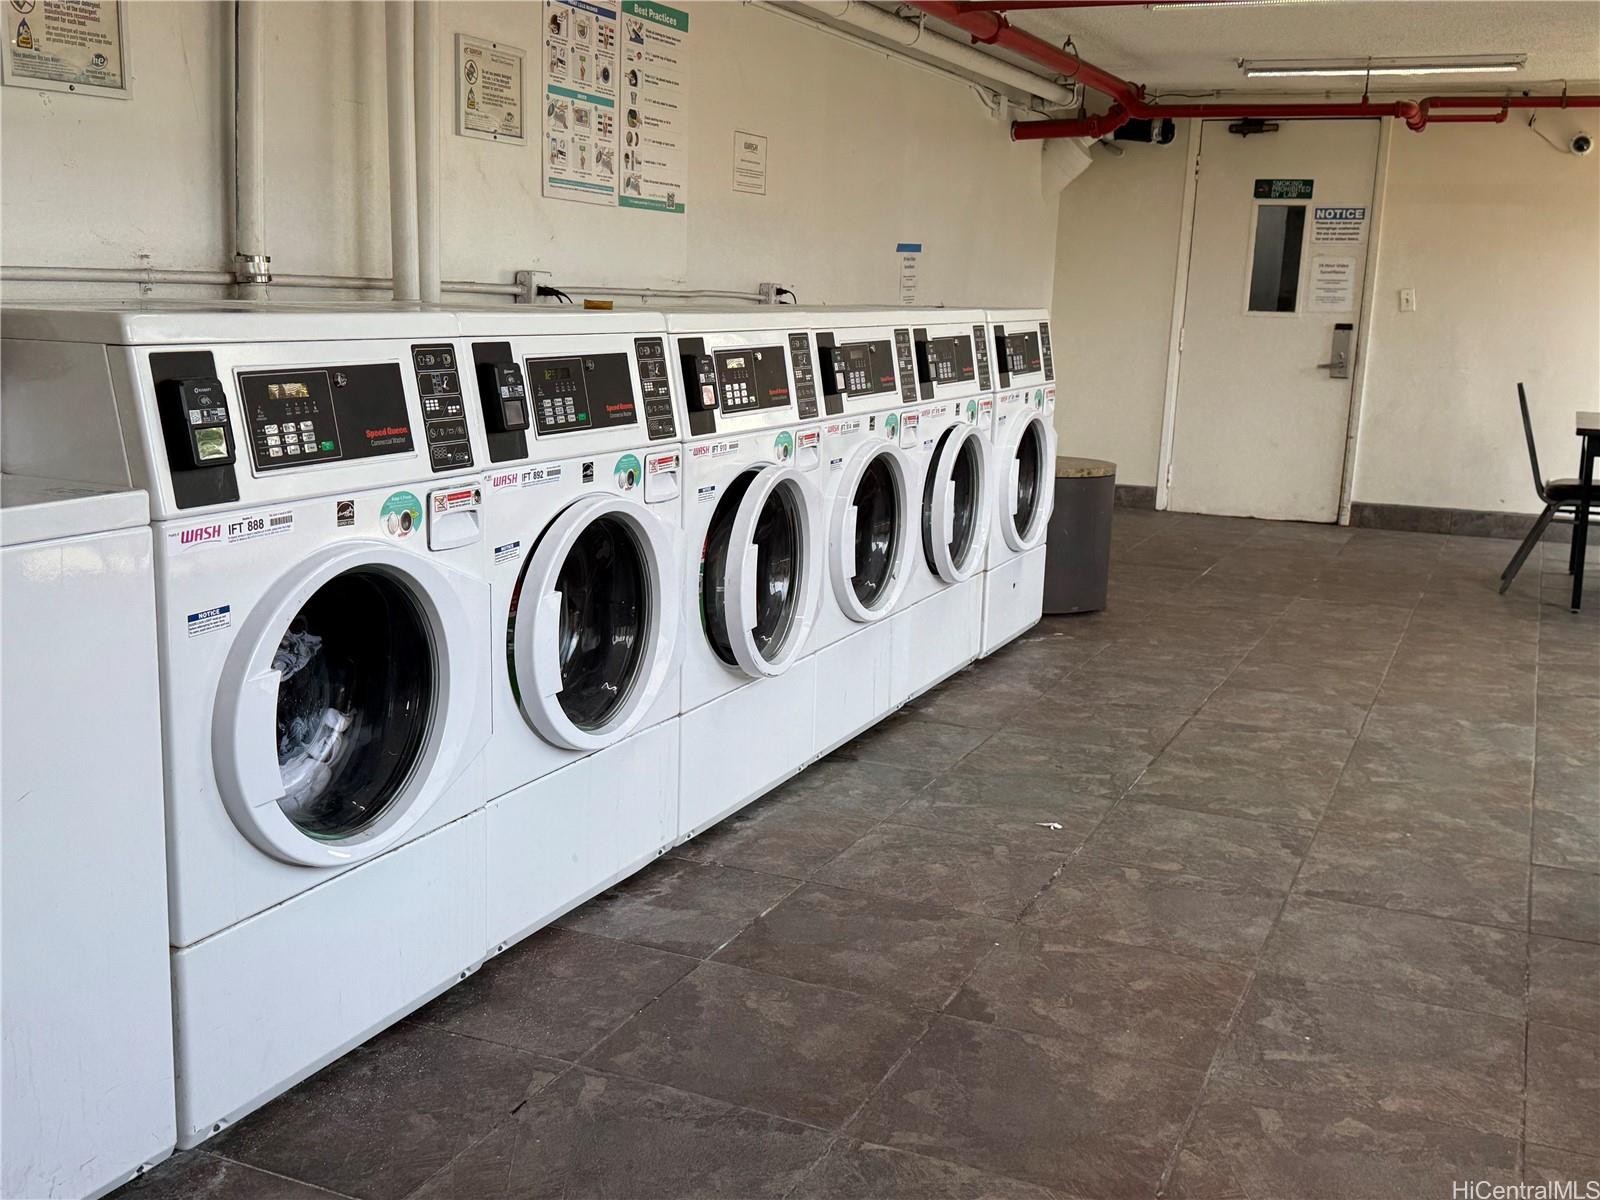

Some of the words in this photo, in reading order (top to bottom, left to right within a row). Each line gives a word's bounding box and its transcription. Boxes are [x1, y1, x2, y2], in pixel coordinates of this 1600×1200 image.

[634, 4, 648, 16] Best
[649, 9, 677, 26] Practices
[1272, 185, 1311, 193] PROHIBITED
[1316, 209, 1364, 219] NOTICE
[606, 404, 620, 412] Speed
[620, 402, 633, 410] Queen
[365, 428, 387, 438] Speed
[387, 426, 409, 435] Queen
[371, 438, 393, 447] Commercial
[393, 436, 406, 444] Washer
[693, 446, 710, 456] WASH
[493, 473, 518, 487] WASH
[521, 472, 532, 482] IFT
[533, 470, 544, 479] 892
[181, 525, 221, 544] WASH
[228, 522, 244, 536] IFT
[247, 518, 265, 532] 888
[198, 609, 220, 619] NOTICE
